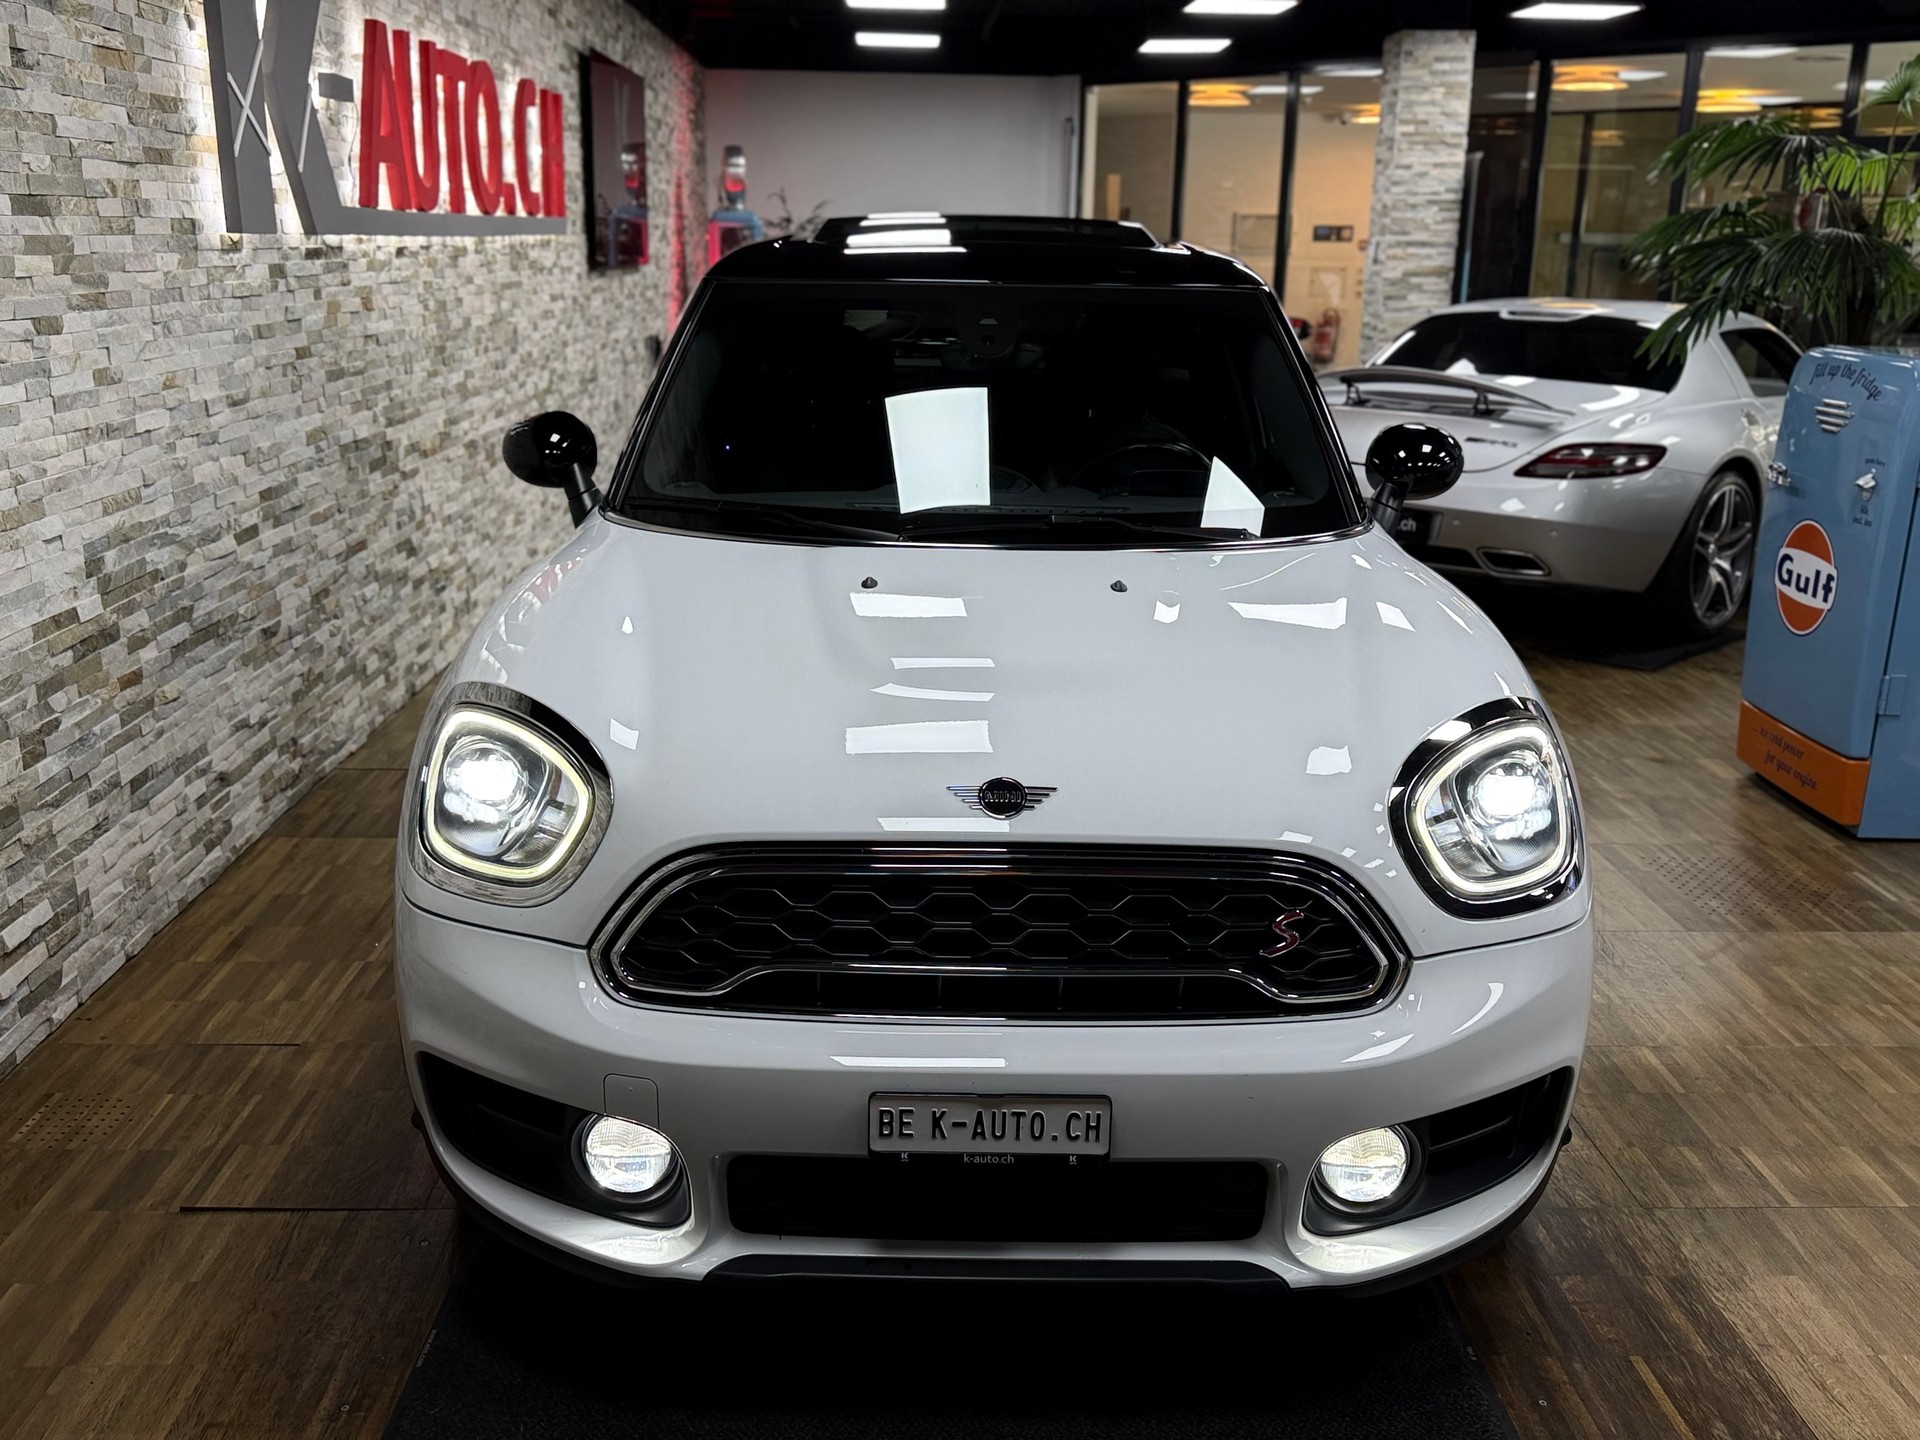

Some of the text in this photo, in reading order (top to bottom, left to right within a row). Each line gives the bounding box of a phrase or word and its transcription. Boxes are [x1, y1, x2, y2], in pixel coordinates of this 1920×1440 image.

[1809, 362, 1882, 401] fill up the fridge
[1777, 553, 1836, 604] Gulf
[1764, 749, 1776, 764] for
[1776, 759, 1793, 775] your
[1259, 909, 1304, 957] S
[878, 1107, 1102, 1142] BE K-AUTO.CH
[963, 1153, 1015, 1164] k-auto.ch
